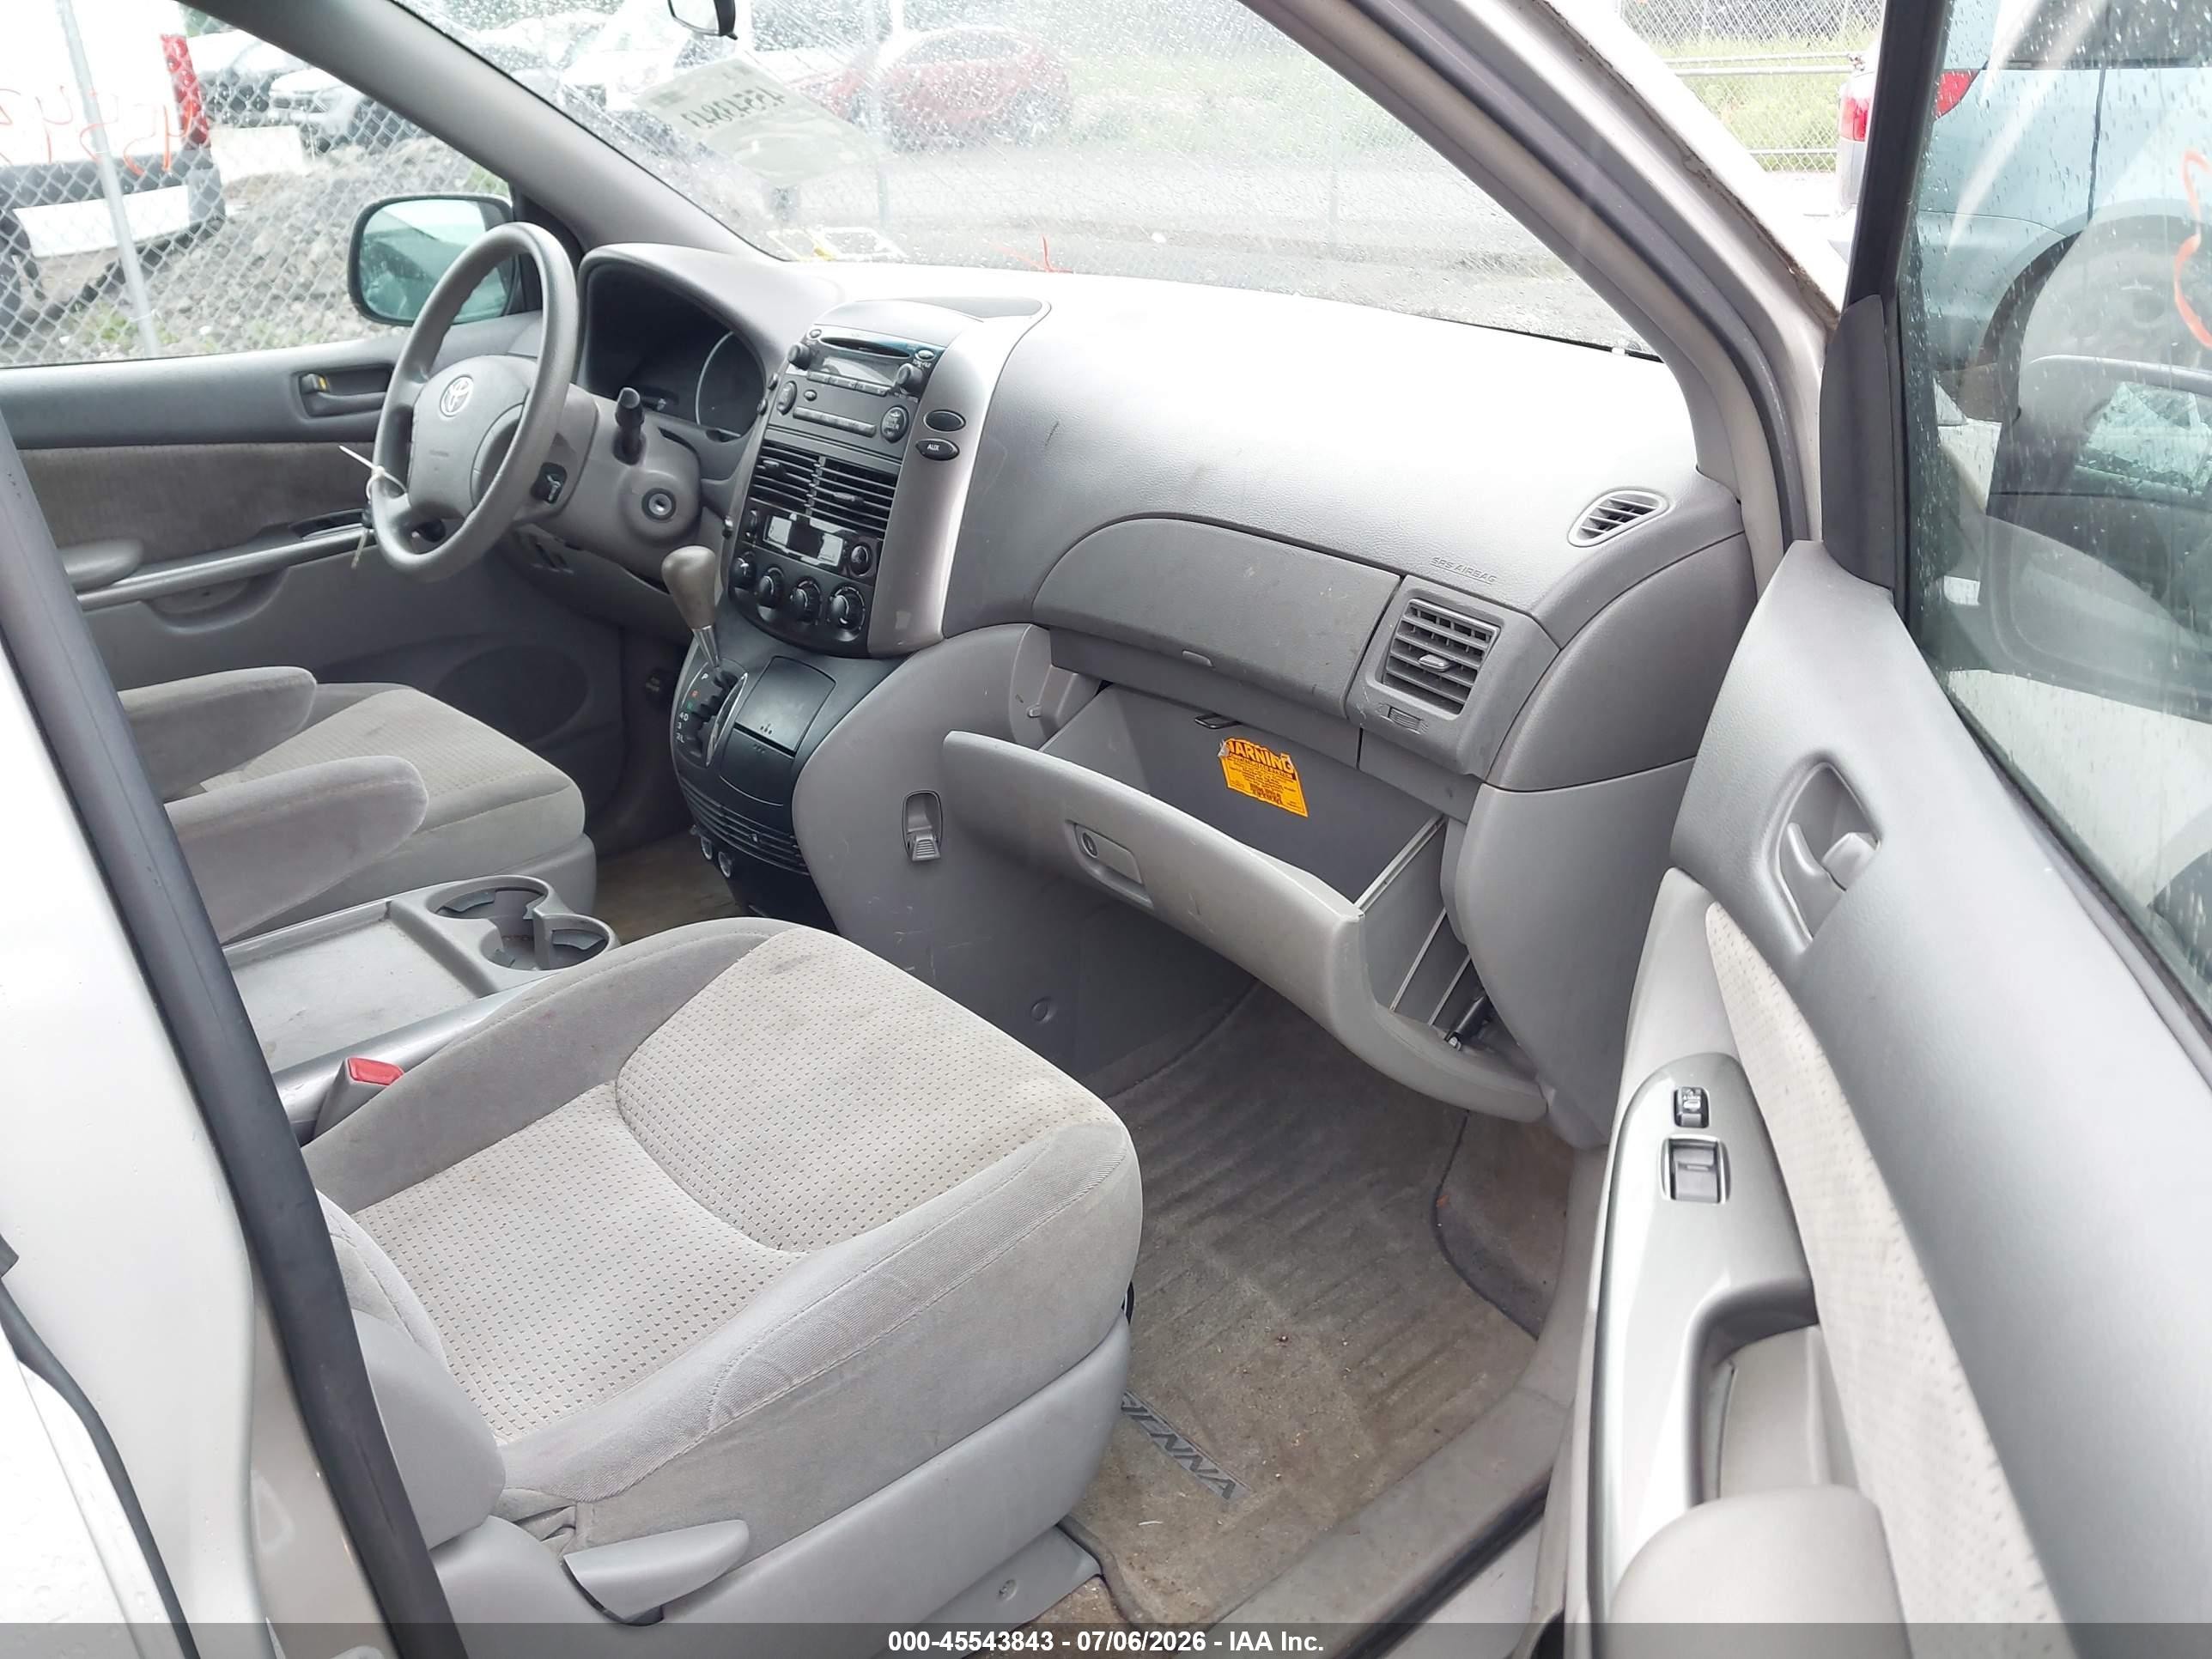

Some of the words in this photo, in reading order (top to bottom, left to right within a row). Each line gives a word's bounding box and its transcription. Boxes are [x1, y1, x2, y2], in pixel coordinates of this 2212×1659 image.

[927, 443, 940, 452] AUX
[1430, 556, 1453, 569] SRS
[1454, 563, 1498, 584] AIRBAG
